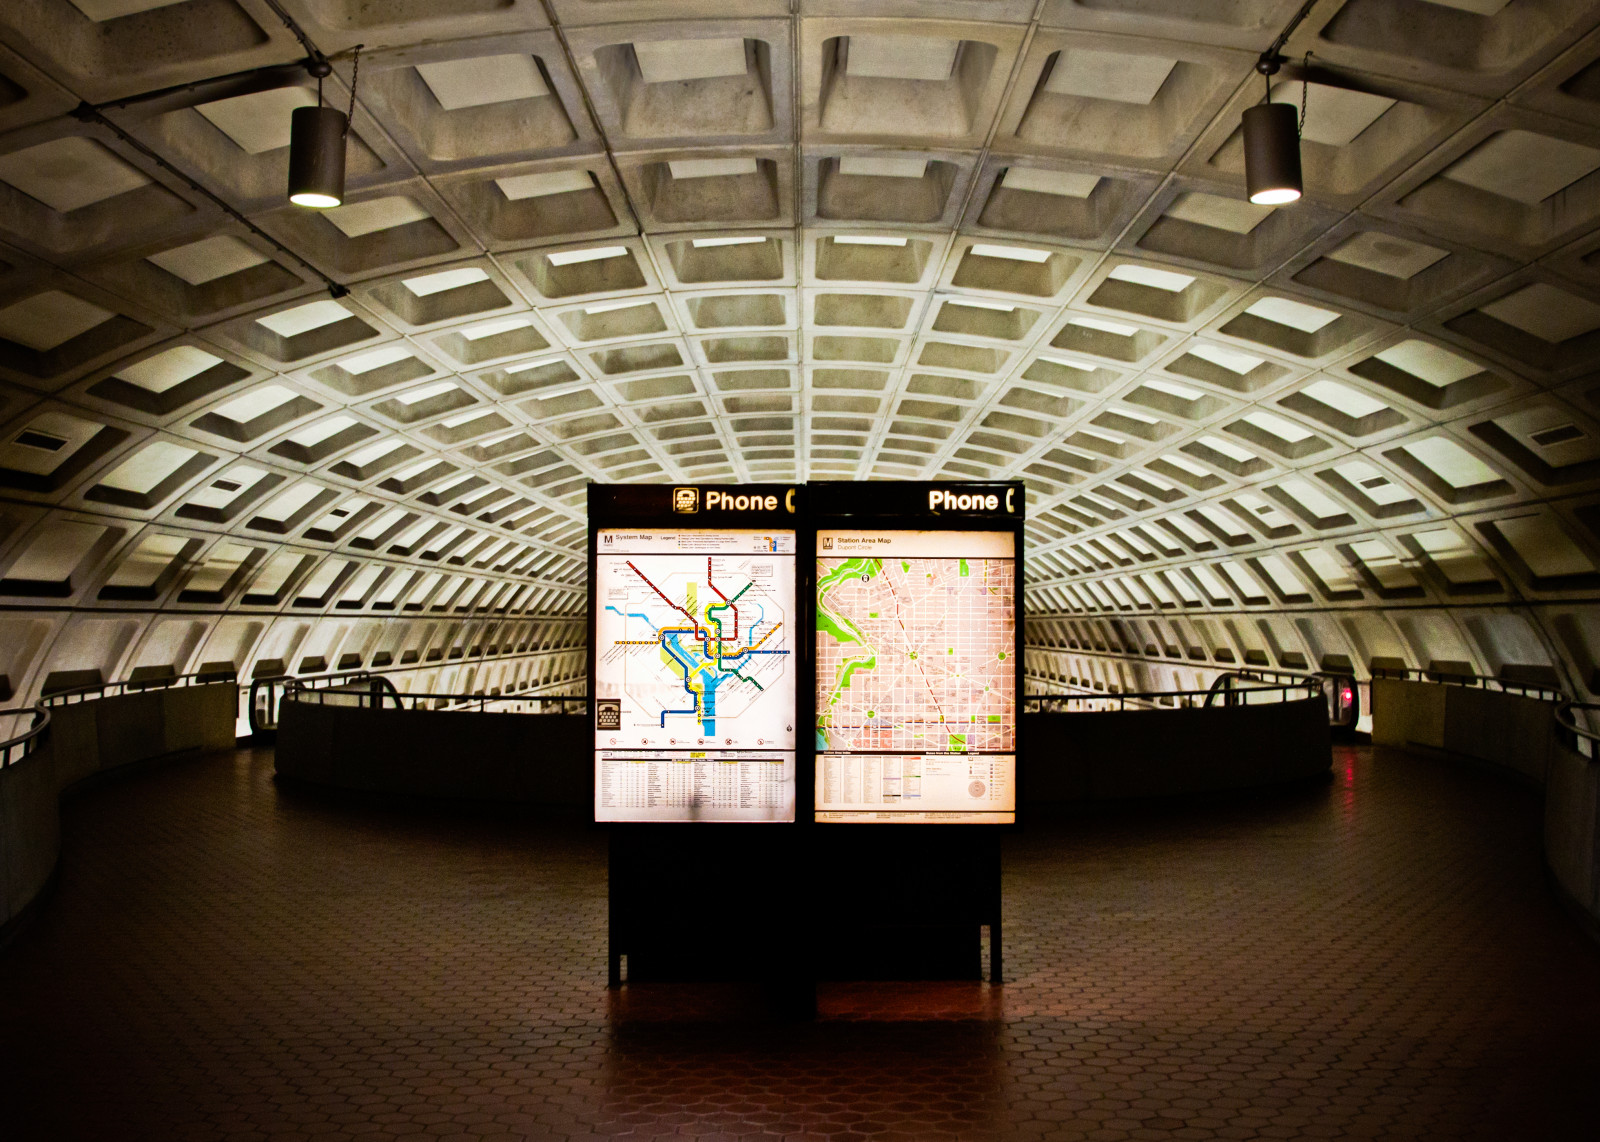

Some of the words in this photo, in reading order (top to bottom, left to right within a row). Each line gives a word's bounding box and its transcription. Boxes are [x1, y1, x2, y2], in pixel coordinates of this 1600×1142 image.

[706, 490, 778, 511] Phone
[929, 490, 999, 511] Phone
[604, 535, 613, 544] M
[877, 537, 892, 545] Map
